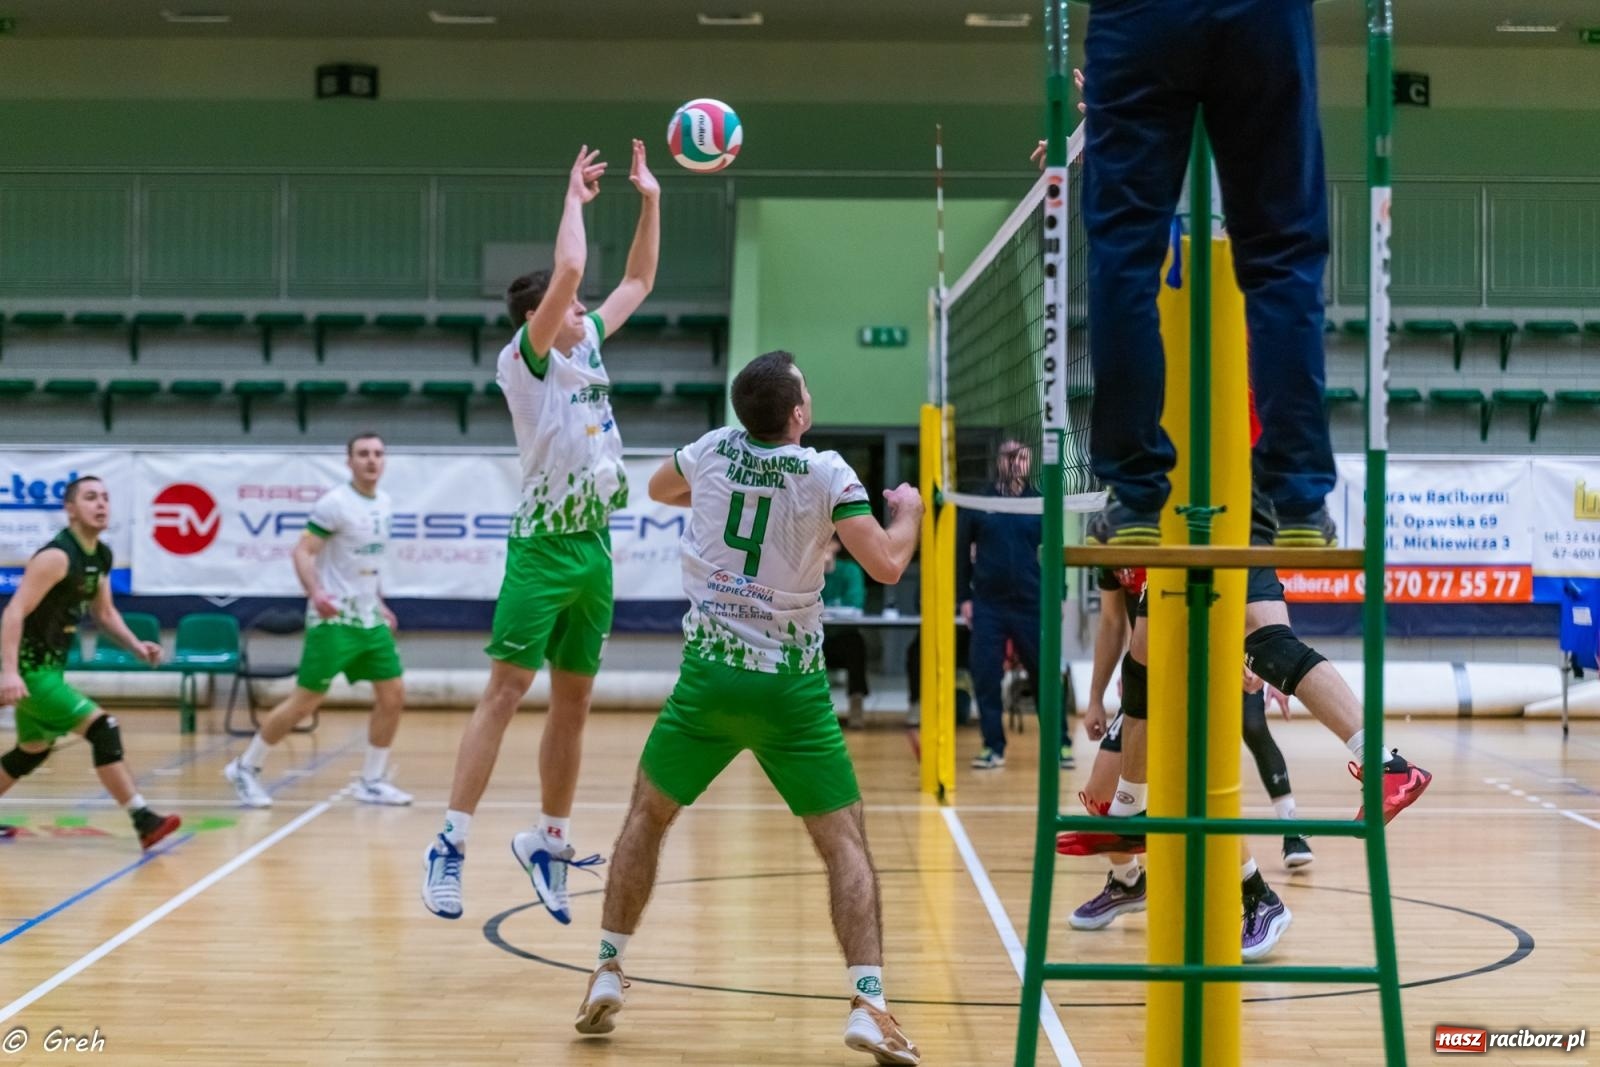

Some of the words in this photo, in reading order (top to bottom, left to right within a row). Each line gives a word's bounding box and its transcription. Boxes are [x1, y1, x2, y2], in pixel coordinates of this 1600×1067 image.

[1409, 82, 1426, 104] C
[1409, 491, 1421, 503] w
[1426, 489, 1509, 504] Raciborzu:
[1404, 514, 1475, 531] Opawska
[1480, 514, 1498, 527] 69
[724, 491, 771, 577] 4
[1404, 535, 1497, 550] Mickiewicza
[1502, 536, 1510, 550] 3
[707, 582, 773, 603] UBEZPIECZENIA
[1279, 573, 1349, 597] aciborz.pl
[1427, 571, 1455, 598] 77
[1460, 571, 1487, 598] 55
[1493, 571, 1521, 598] 77
